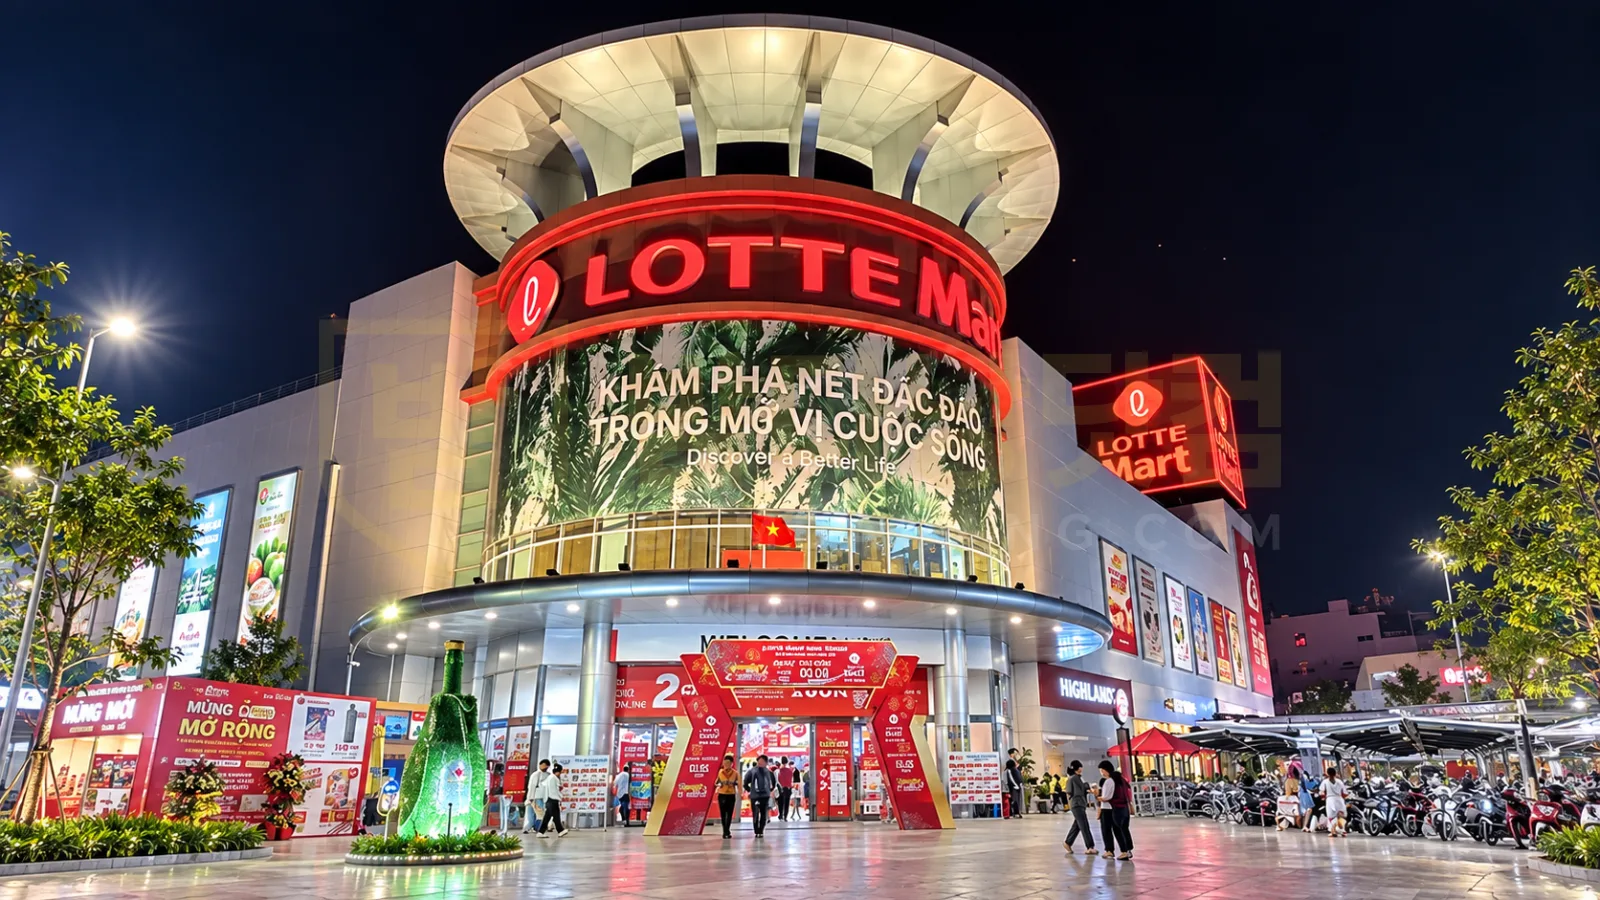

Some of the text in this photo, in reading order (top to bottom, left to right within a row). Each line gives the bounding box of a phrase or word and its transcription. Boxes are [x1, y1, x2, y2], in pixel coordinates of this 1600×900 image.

[585, 236, 1000, 362] LOTTE Mar
[599, 362, 700, 407] KHÁM
[711, 357, 789, 395] PHÁ
[798, 362, 865, 401] NÉT
[588, 407, 709, 447] TRONG
[789, 407, 824, 444] VỊ
[833, 410, 924, 454] CUỘC
[1097, 424, 1188, 457] LOTTE
[686, 448, 898, 475] Discover a Better Life
[1102, 444, 1192, 482] Mart
[652, 672, 680, 709] 2
